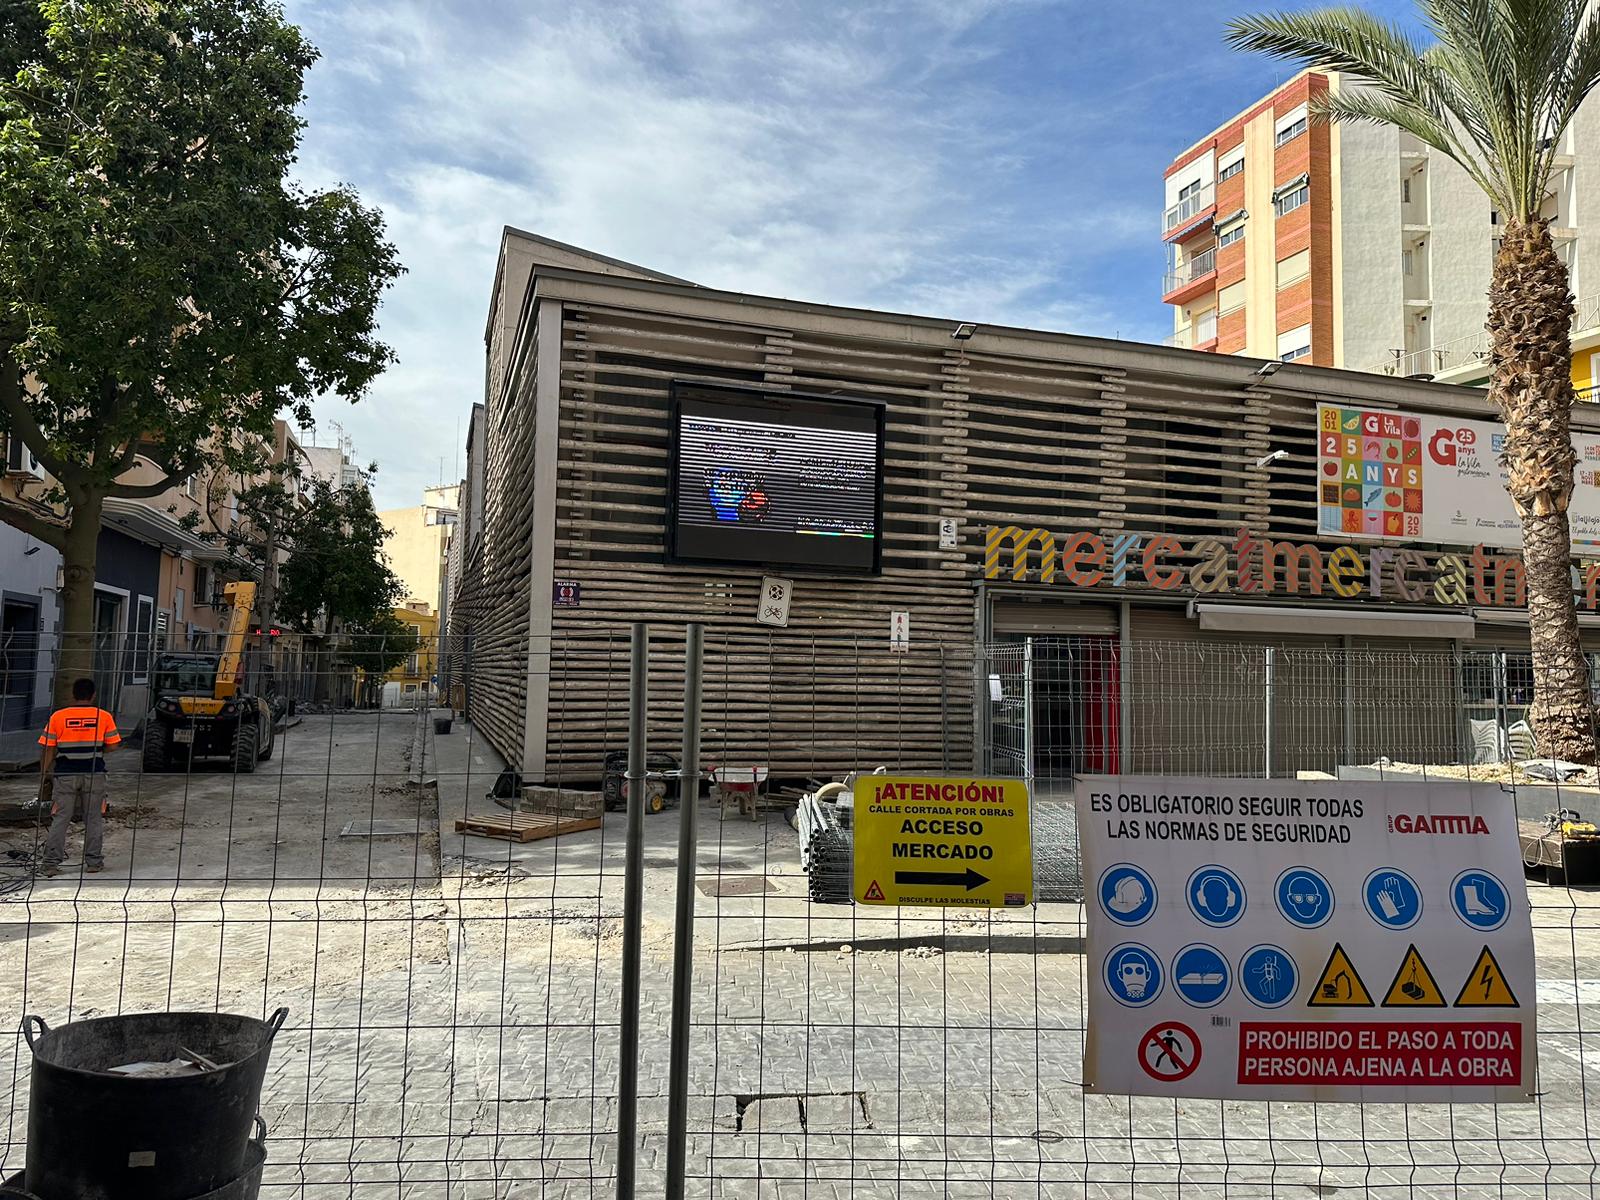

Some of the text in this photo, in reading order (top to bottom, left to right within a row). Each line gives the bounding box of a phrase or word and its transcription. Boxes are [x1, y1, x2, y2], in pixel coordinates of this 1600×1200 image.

[1324, 410, 1337, 420] 20
[1384, 416, 1394, 425] La
[1324, 420, 1337, 430] 01
[1365, 415, 1379, 433] G
[1384, 425, 1401, 435] Vila
[1459, 430, 1472, 442] 25
[1428, 428, 1457, 466] G
[1458, 446, 1475, 456] anys
[875, 781, 1004, 804] ¡ATENCIÓN!
[869, 805, 1014, 817] CALLE CORTADA POR OBRAS
[1090, 793, 1364, 818] ES OBLIGATORIO SEGUIR TODAS
[900, 819, 983, 836] ACCESO
[1107, 820, 1351, 843] LAS NORMAS DE SEGURIDAD
[892, 842, 993, 860] MERCADO
[950, 897, 991, 905] MOLESTIAS
[1245, 1030, 1514, 1050] PROHIBIDO EL PASO A TODA
[1244, 1057, 1515, 1077] PERSONA AJENA A LA OBRA
